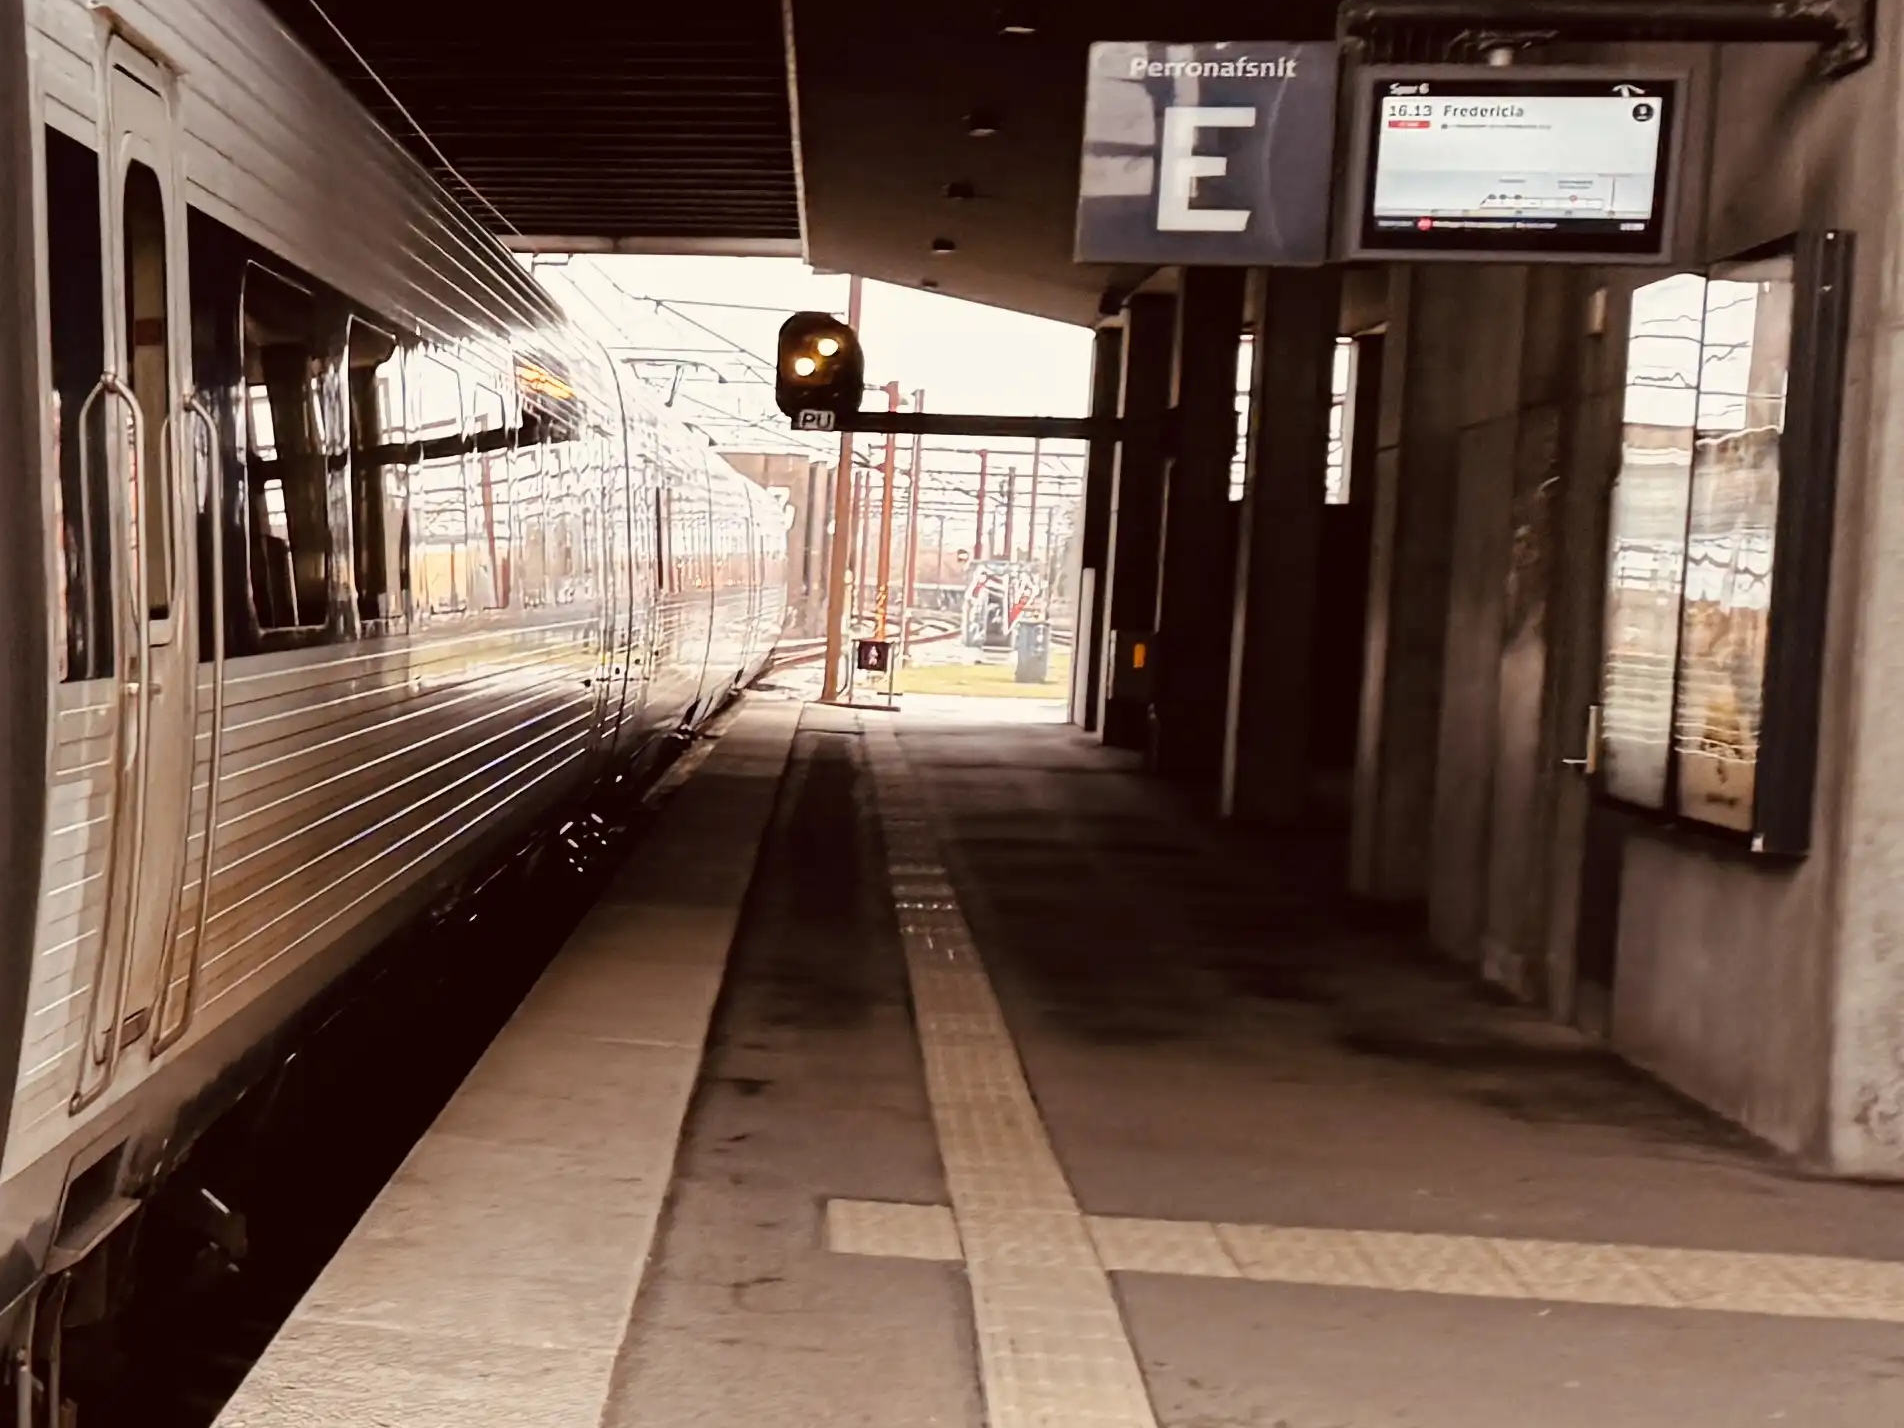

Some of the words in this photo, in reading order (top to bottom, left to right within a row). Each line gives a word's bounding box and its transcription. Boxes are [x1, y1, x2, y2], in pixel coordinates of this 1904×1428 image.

[1129, 56, 1297, 78] Perronafsnit
[1388, 104, 1433, 117] 16.13
[1443, 104, 1525, 118] Fredericia
[1156, 106, 1256, 232] E
[802, 412, 831, 428] PU
